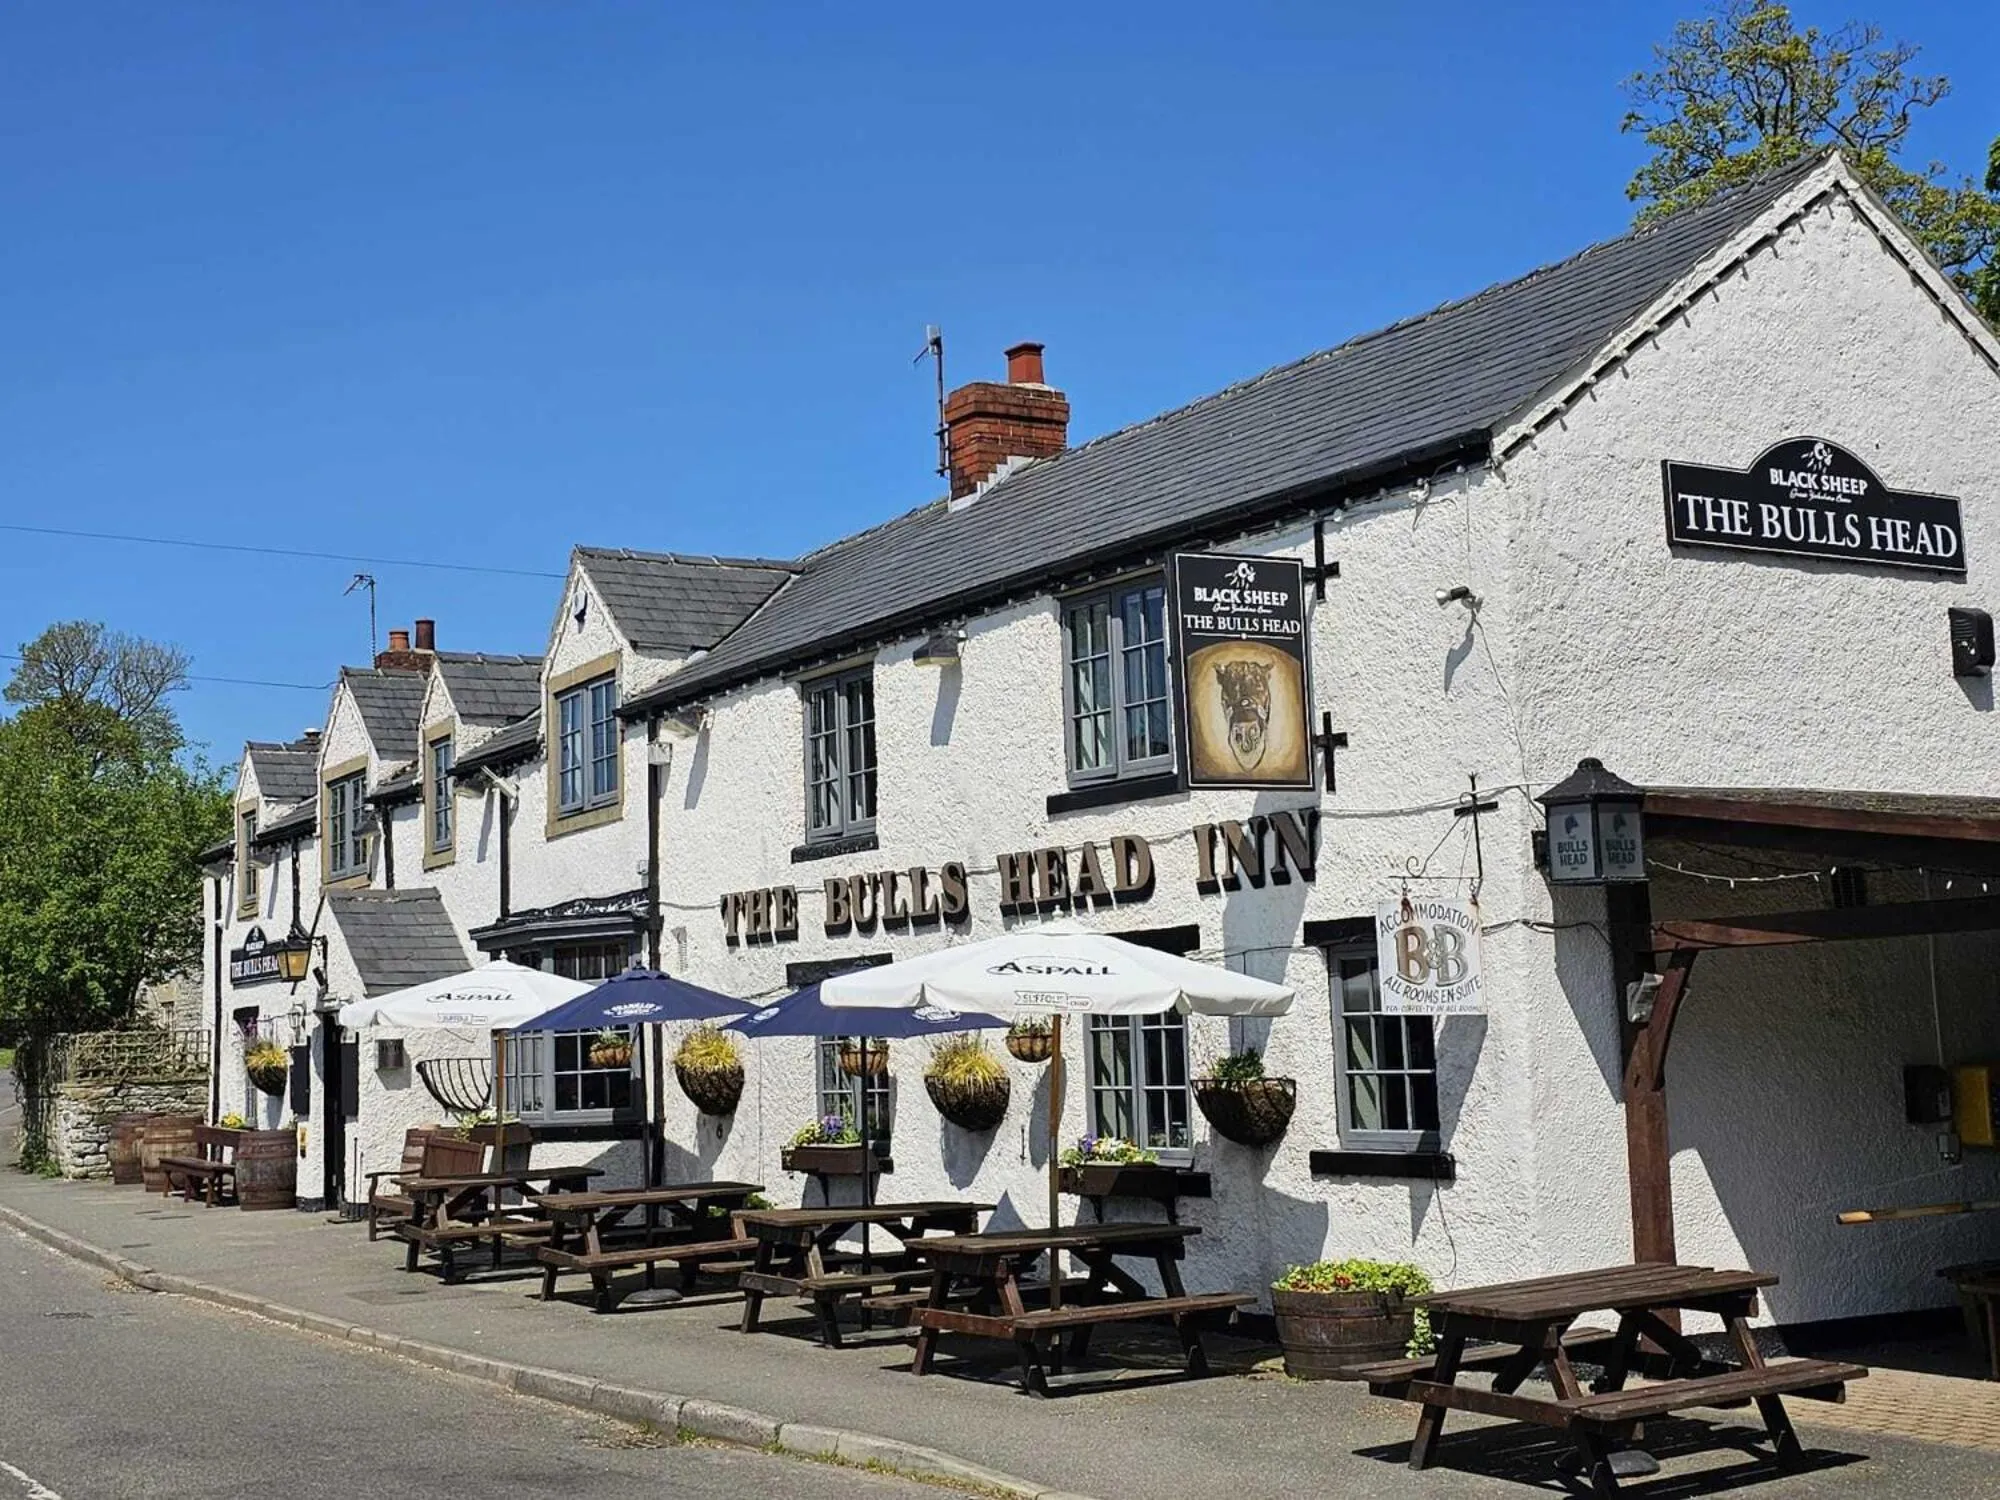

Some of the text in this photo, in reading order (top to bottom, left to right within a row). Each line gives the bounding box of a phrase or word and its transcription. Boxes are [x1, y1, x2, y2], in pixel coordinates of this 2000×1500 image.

[1769, 468, 1819, 490] BLACK
[1820, 475, 1868, 496] SHEEP
[1678, 492, 1958, 558] THE BULLS HEAD
[1193, 587, 1289, 607] BLACK SHEEP
[1183, 614, 1301, 634] THE BULLS HEAD
[1557, 840, 1589, 854] BULLS
[1559, 852, 1588, 867] HEAD
[720, 807, 1319, 946] THE BULLS HEAD INN
[262, 954, 280, 973] HEA
[1393, 923, 1468, 988] B&B
[986, 961, 1118, 976] ASPALL
[426, 992, 515, 1003] ASPALL
[1382, 976, 1401, 995] ALL
[1402, 985, 1440, 1005] ROOMS
